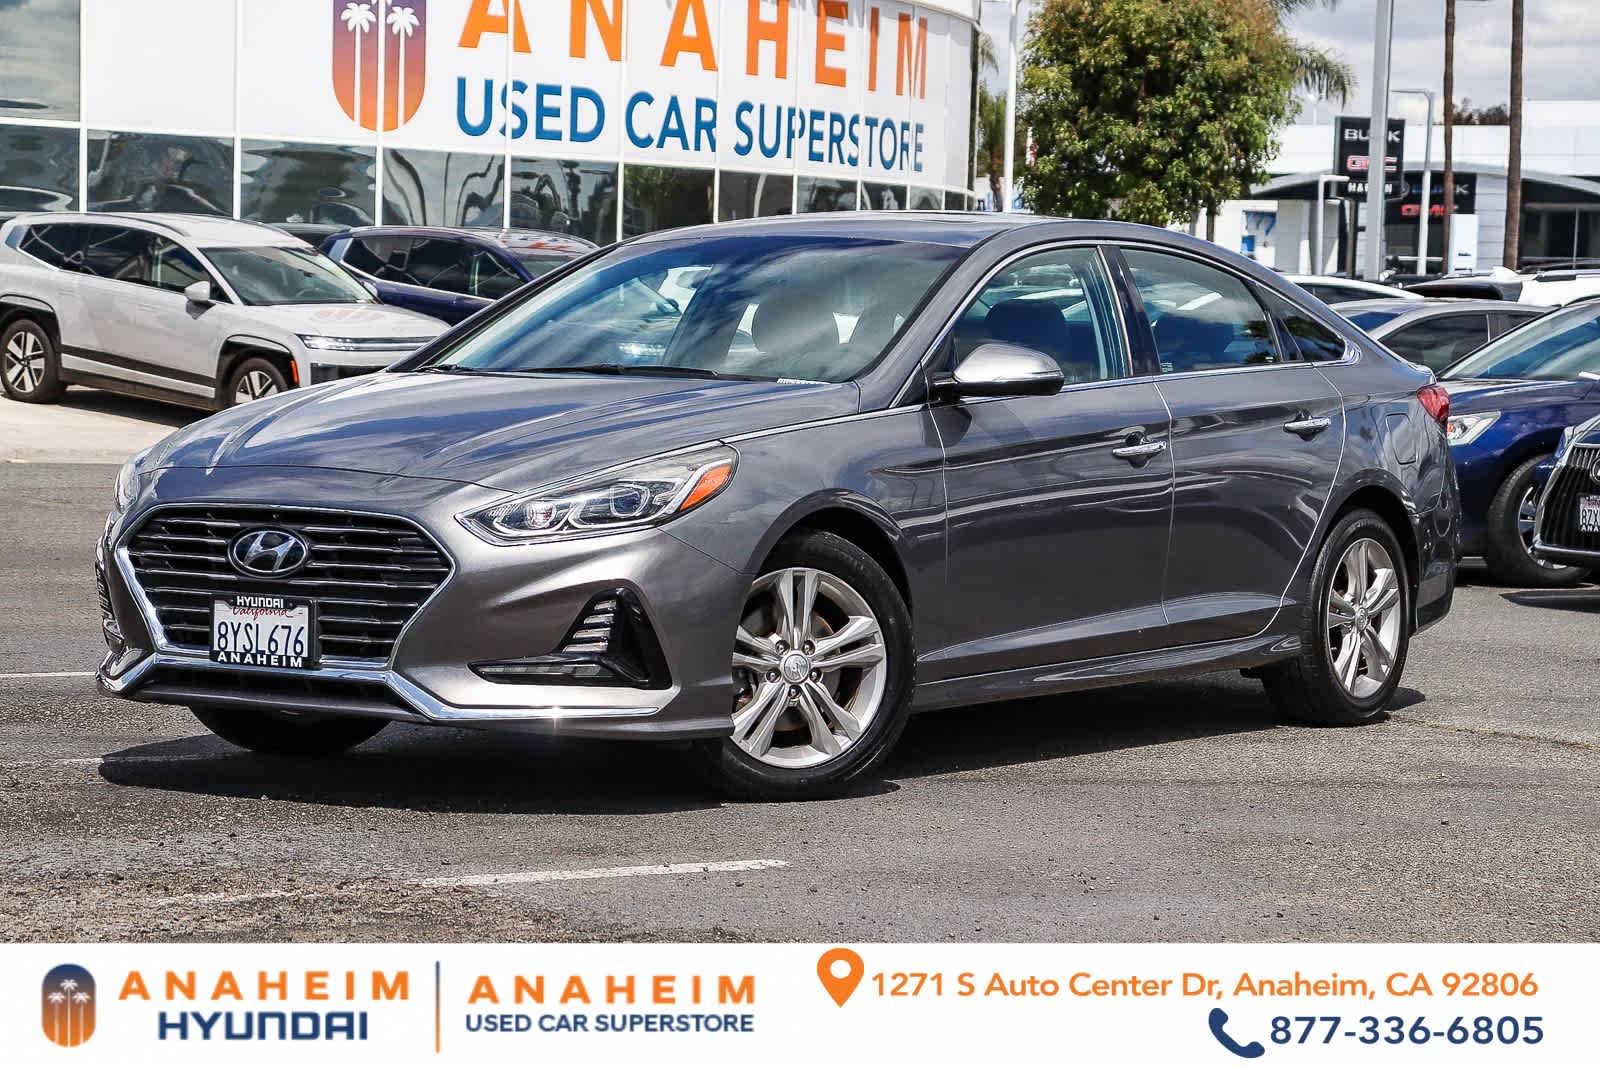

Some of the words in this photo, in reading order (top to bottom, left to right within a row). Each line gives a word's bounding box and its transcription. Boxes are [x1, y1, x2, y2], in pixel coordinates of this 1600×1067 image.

[456, 76, 605, 143] USED
[625, 91, 717, 152] CAR
[733, 100, 925, 173] SUPERSTORE
[1344, 128, 1401, 143] BUK
[236, 595, 284, 609] HYUNDAI
[217, 621, 305, 657] 8YSL676
[217, 651, 303, 668] ANAHEIM
